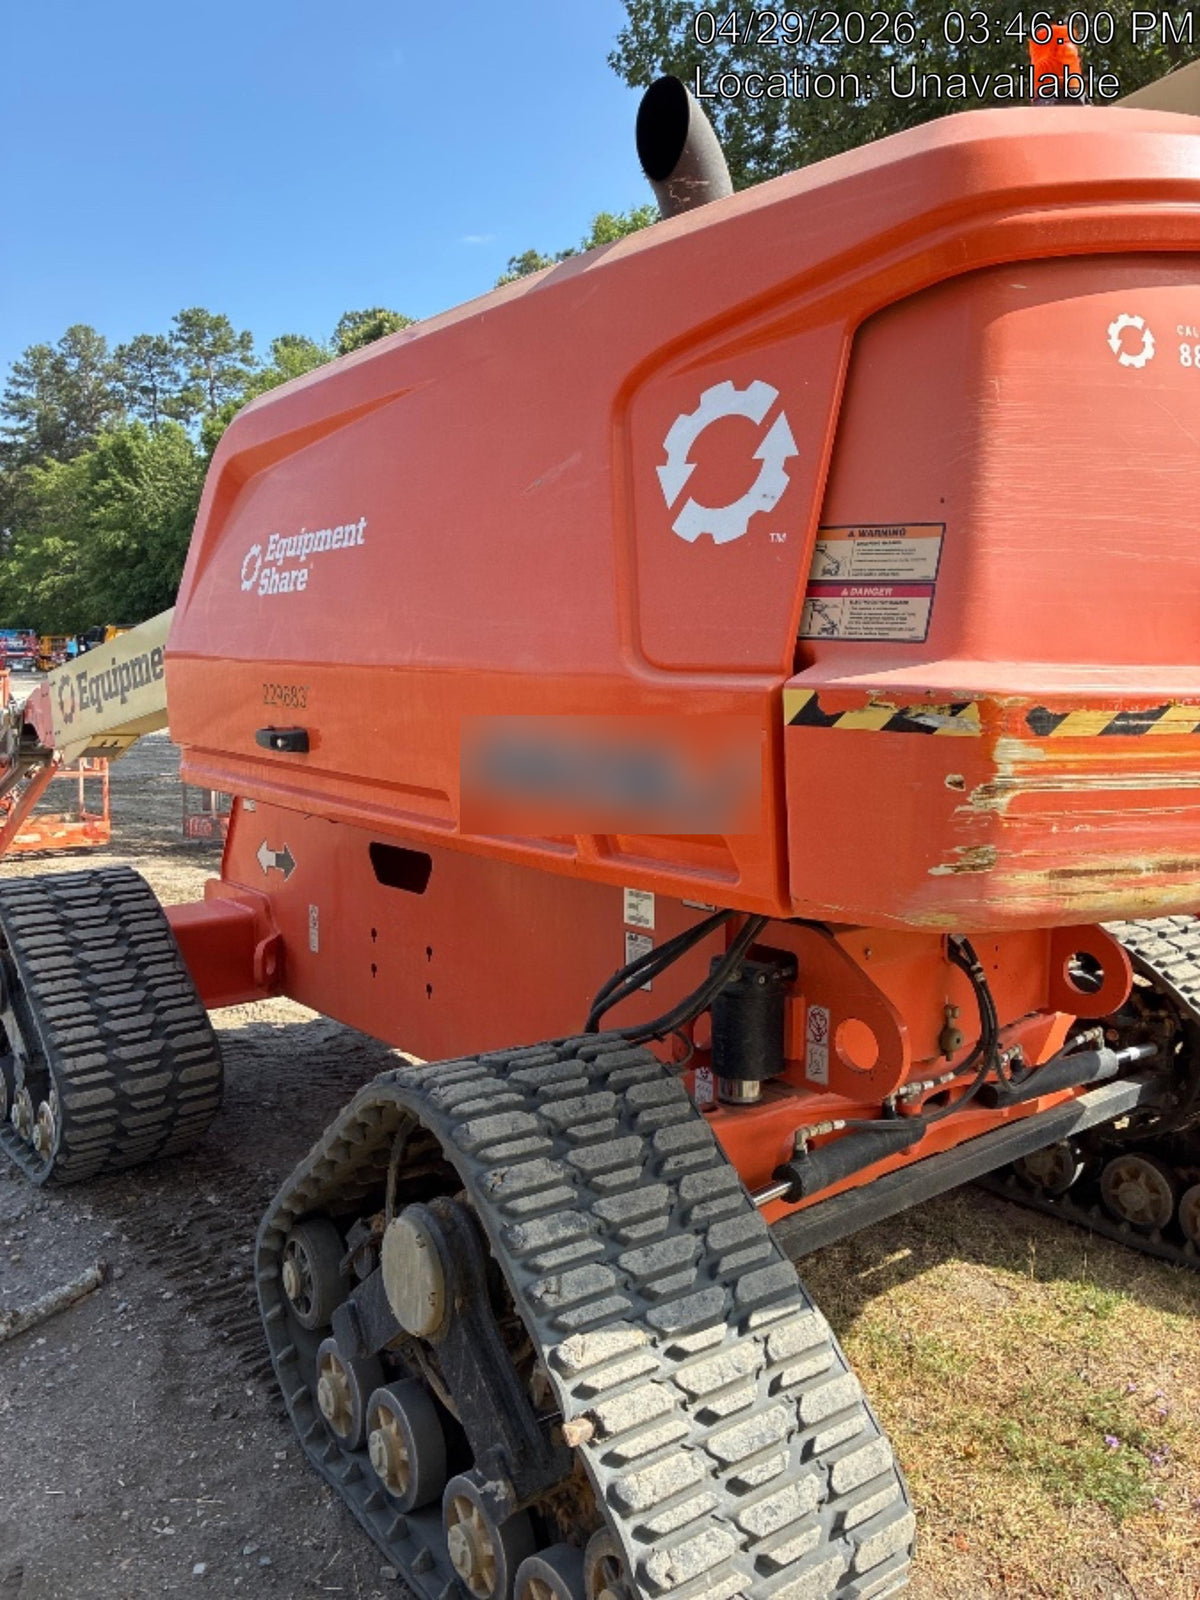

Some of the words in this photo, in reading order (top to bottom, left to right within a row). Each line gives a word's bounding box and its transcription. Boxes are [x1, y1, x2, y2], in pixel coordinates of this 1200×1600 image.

[265, 517, 366, 565] Equipment
[858, 528, 906, 537] WARNING
[258, 567, 308, 595] Share
[850, 588, 893, 597] DANGER
[76, 645, 165, 713] Equipme
[262, 683, 307, 709] 229683
